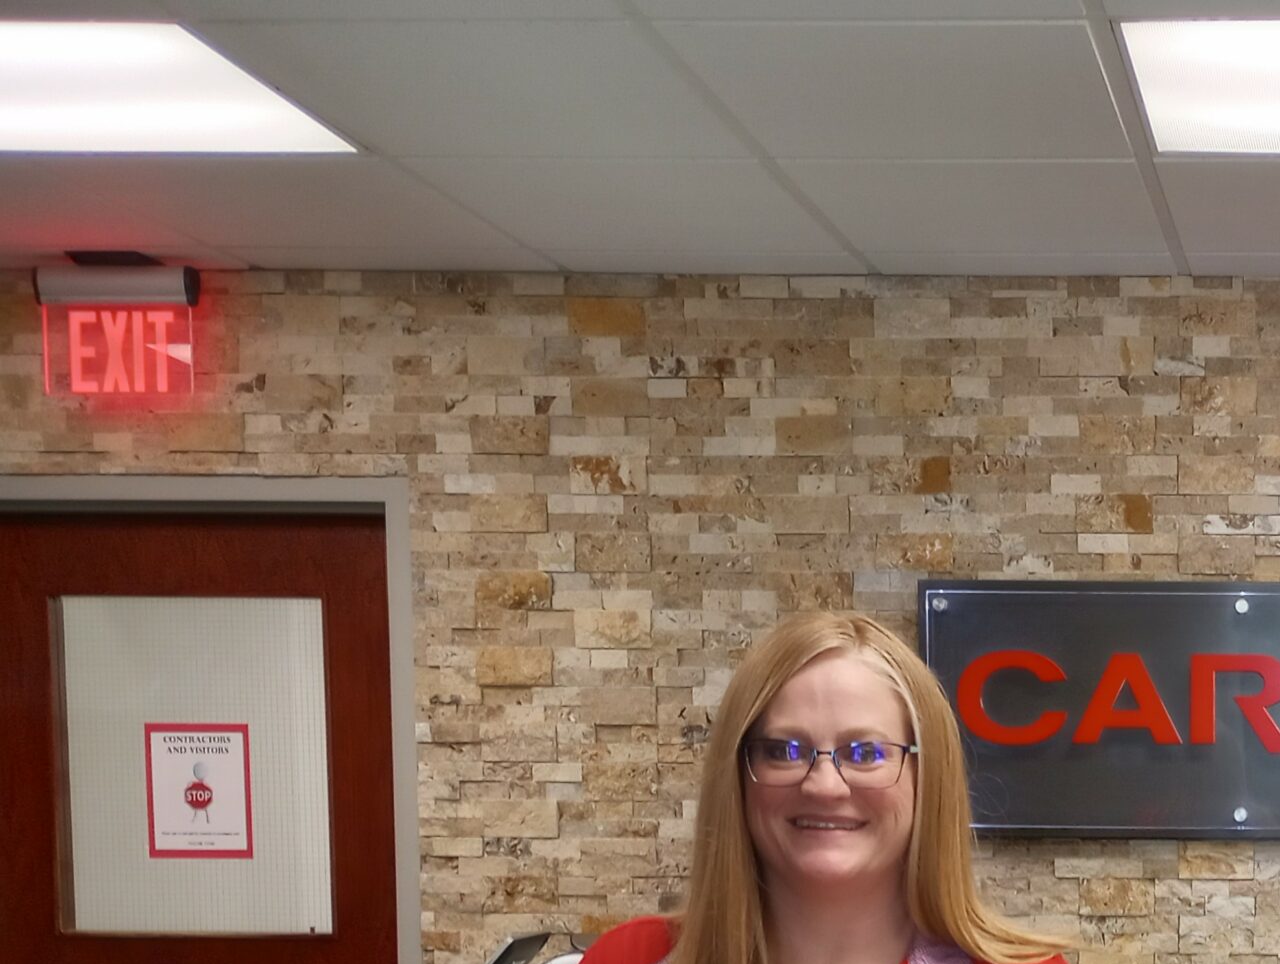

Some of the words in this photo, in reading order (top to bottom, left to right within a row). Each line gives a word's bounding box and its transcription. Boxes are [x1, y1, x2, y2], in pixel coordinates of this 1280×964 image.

[68, 310, 174, 393] EXIT
[162, 735, 231, 744] CONTRACTORS
[167, 746, 187, 754] AND
[189, 746, 230, 755] VISITORS
[186, 790, 212, 802] STOP
